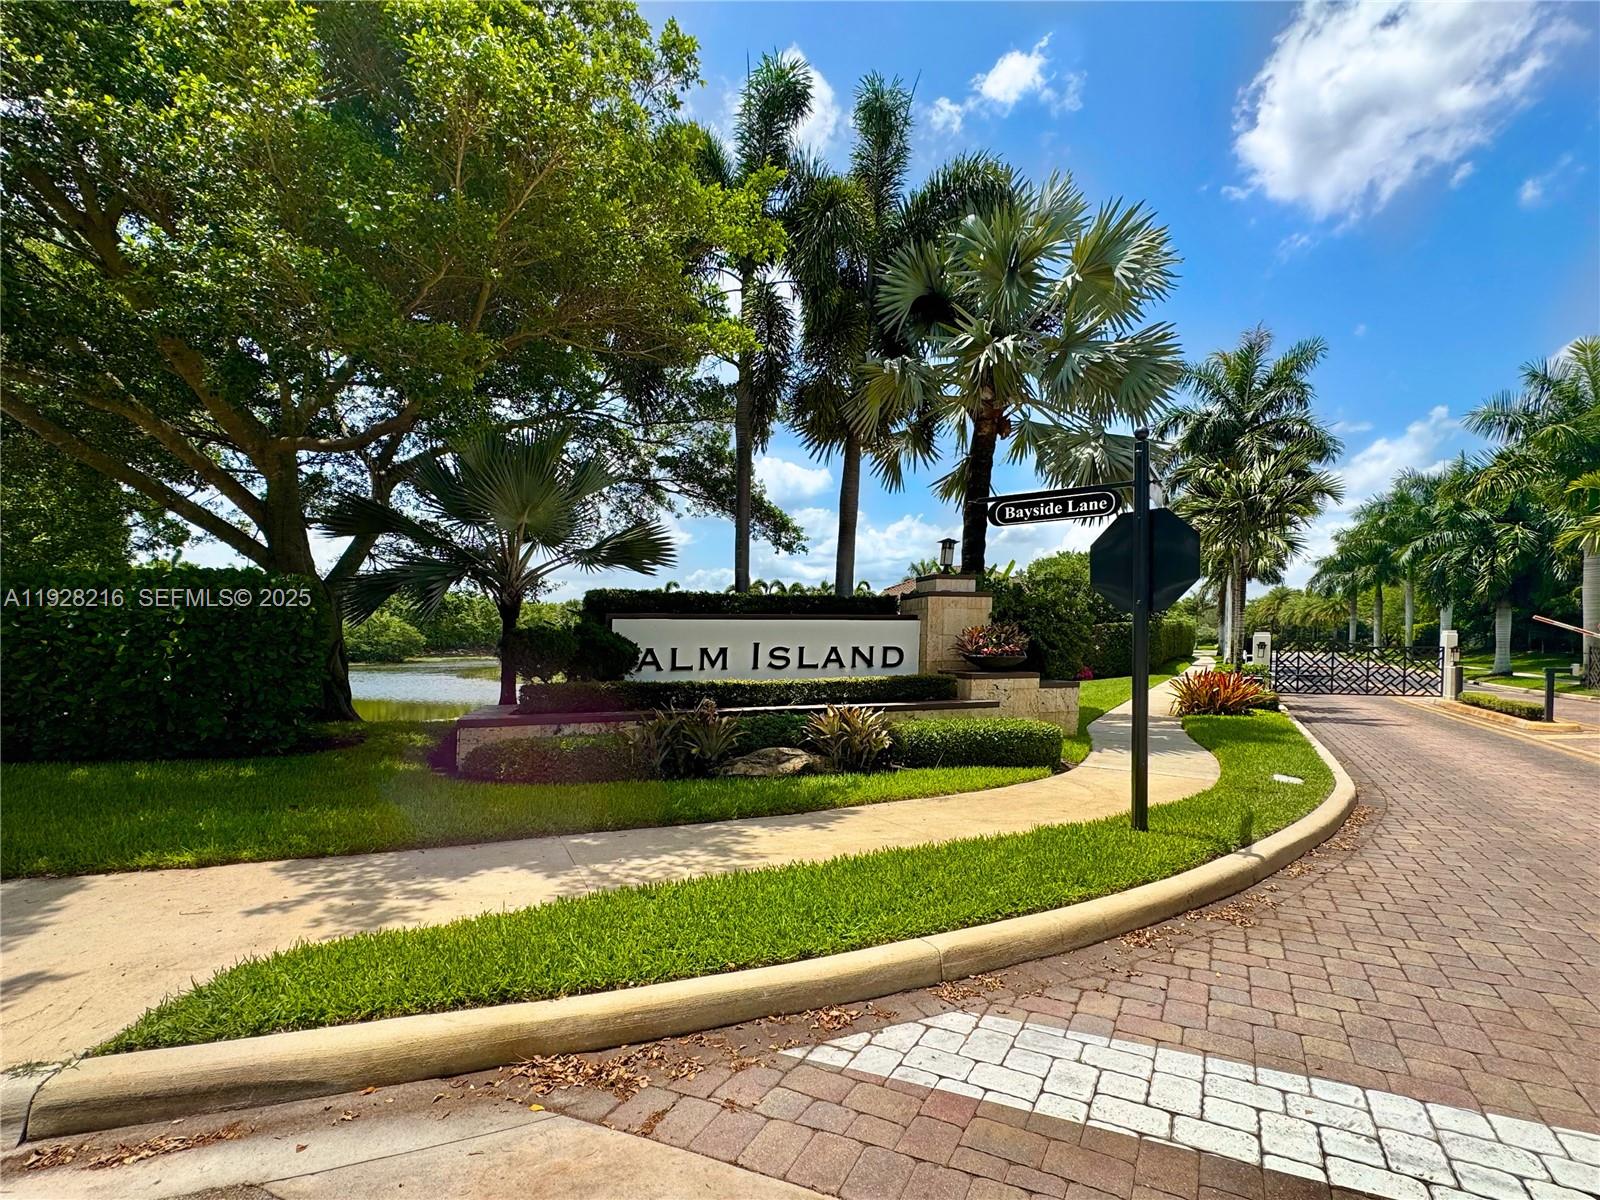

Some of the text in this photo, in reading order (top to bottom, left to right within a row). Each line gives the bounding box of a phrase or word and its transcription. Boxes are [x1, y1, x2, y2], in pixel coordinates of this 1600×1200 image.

[1005, 499, 1108, 520] Bayside Lane
[635, 642, 905, 672] ALM ISLAND
